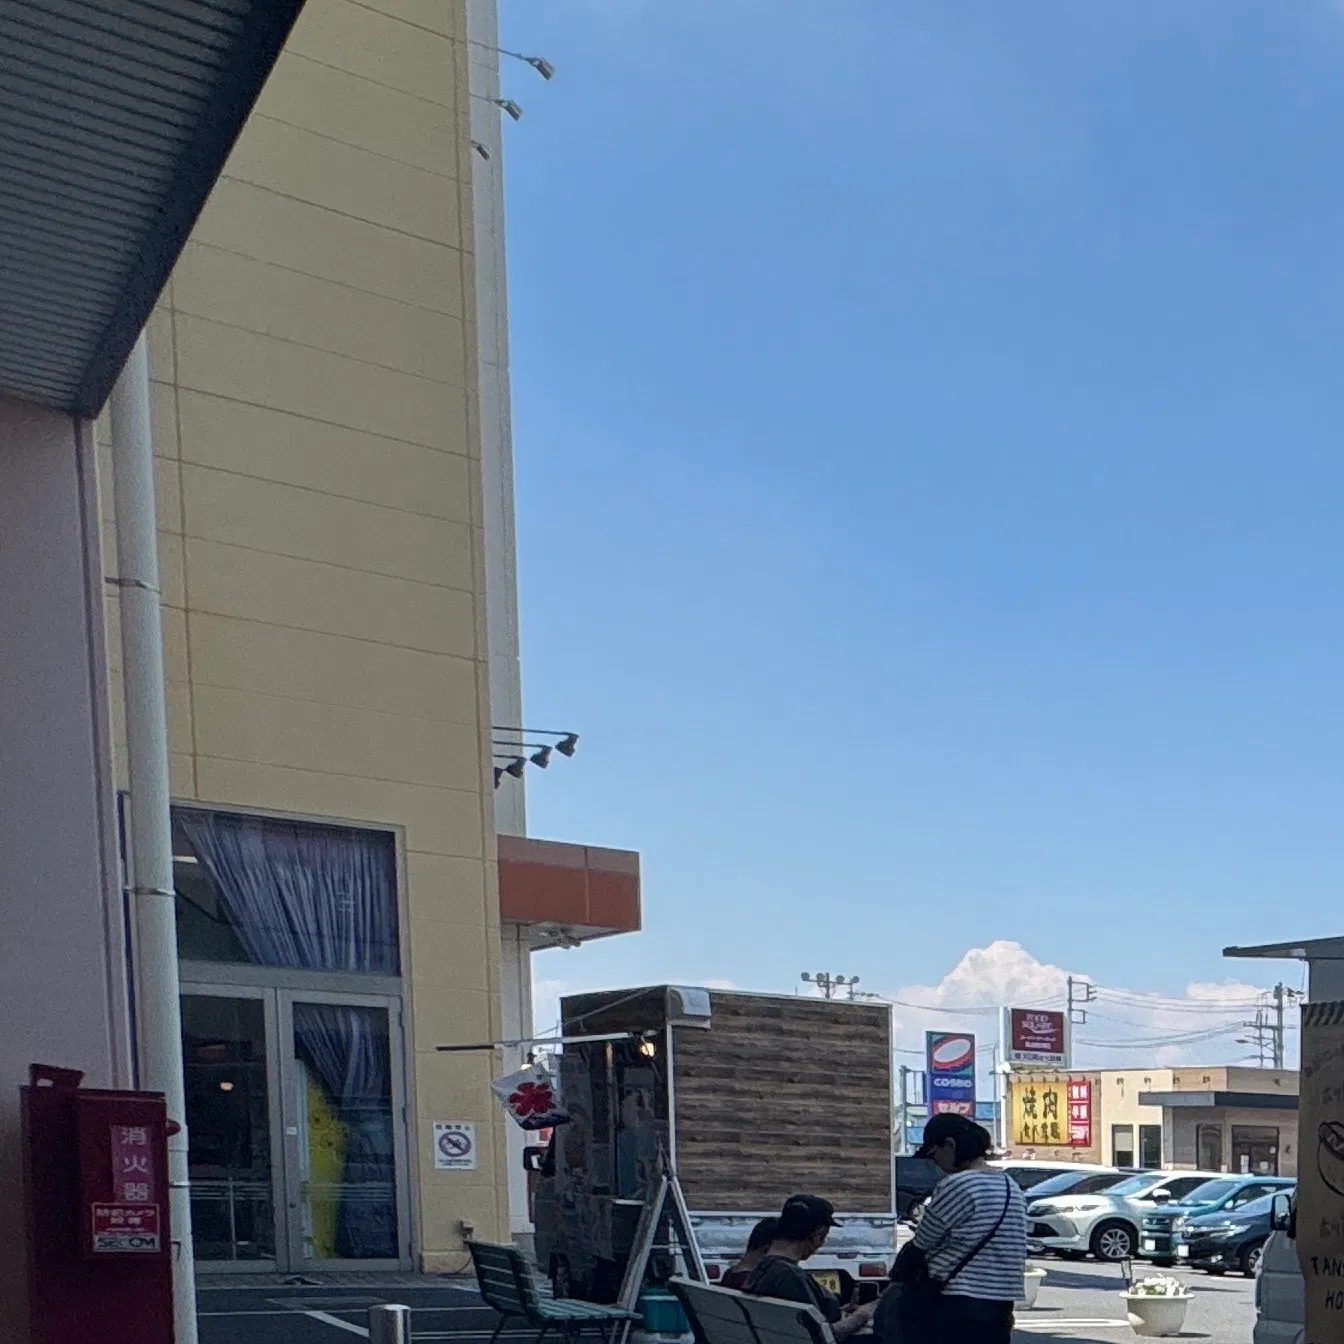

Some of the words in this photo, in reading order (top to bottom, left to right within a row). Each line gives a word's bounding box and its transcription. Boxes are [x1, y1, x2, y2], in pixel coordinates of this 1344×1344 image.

[933, 1078, 973, 1088] COSMO
[120, 1126, 149, 1201] 消火器
[97, 1236, 156, 1249] SECOM
